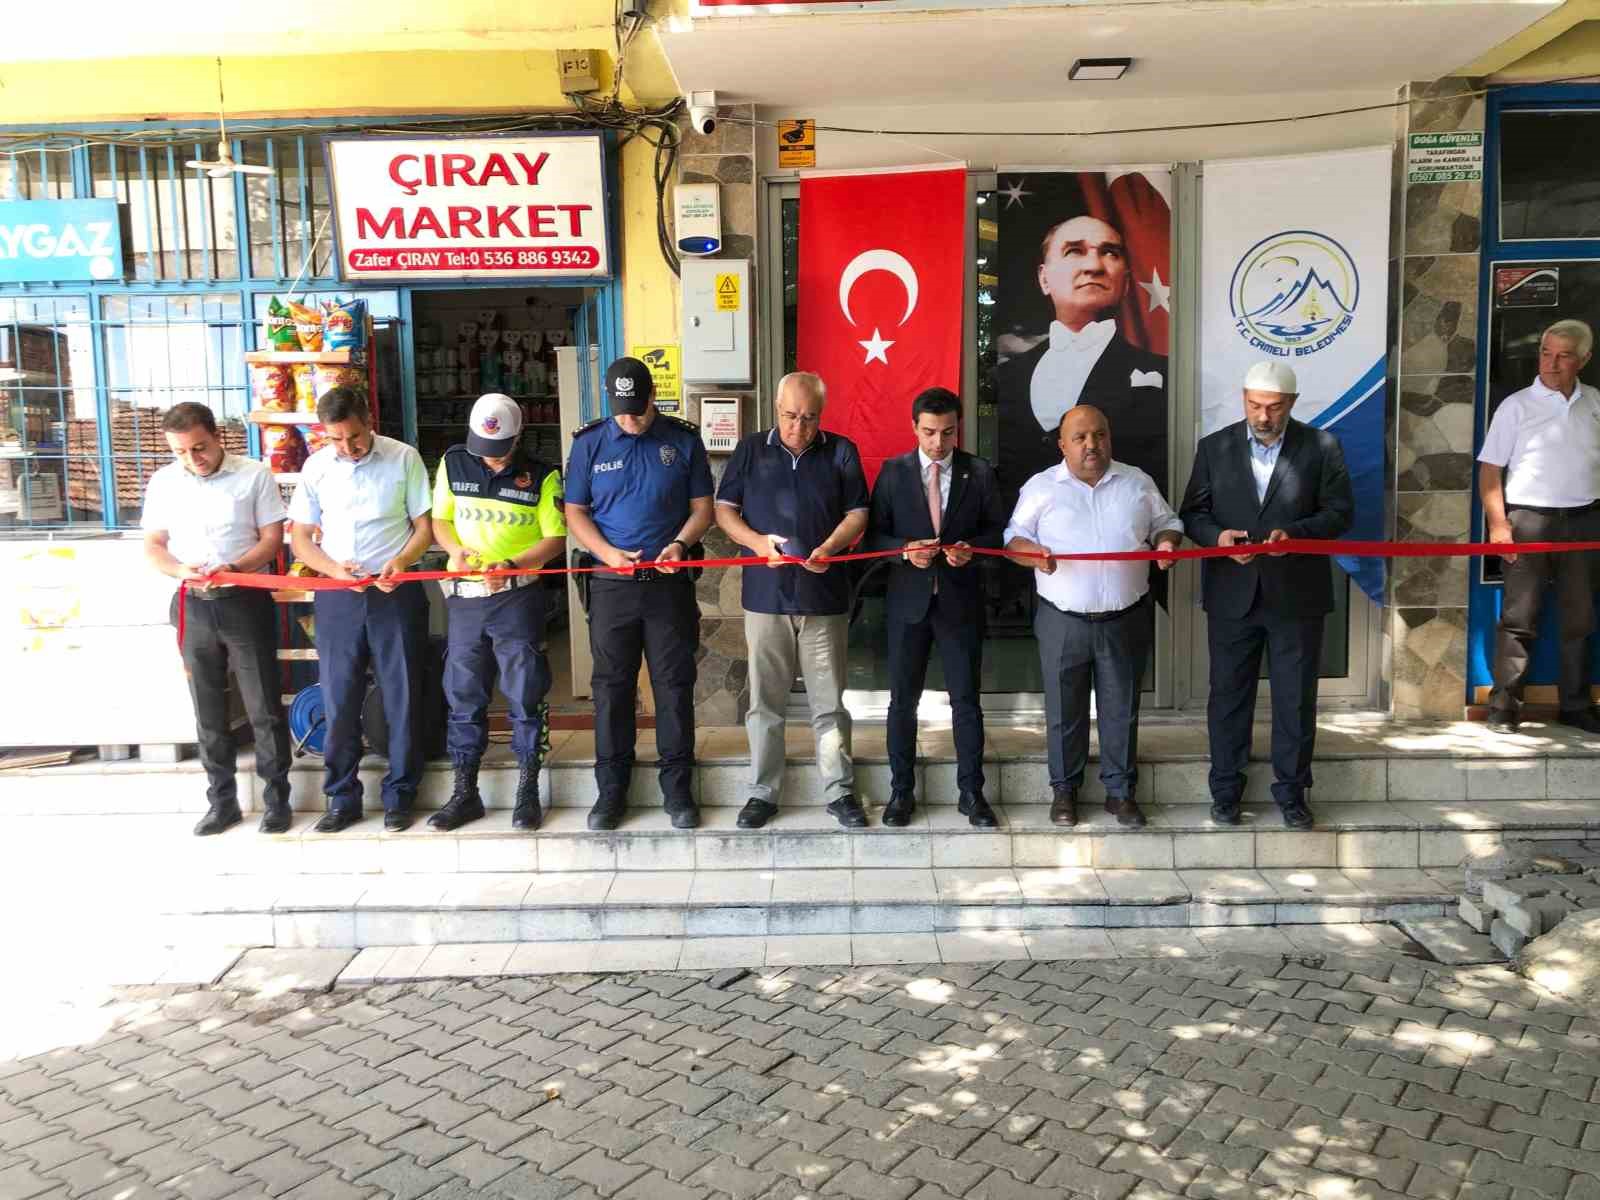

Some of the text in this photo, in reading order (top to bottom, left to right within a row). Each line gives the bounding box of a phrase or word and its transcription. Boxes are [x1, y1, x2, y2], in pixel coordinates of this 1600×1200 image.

[388, 152, 551, 196] ÇIRAY
[355, 204, 593, 240] MARKET
[354, 250, 591, 270] Zafer ÇIRAY Tel:0 536 886 9342
